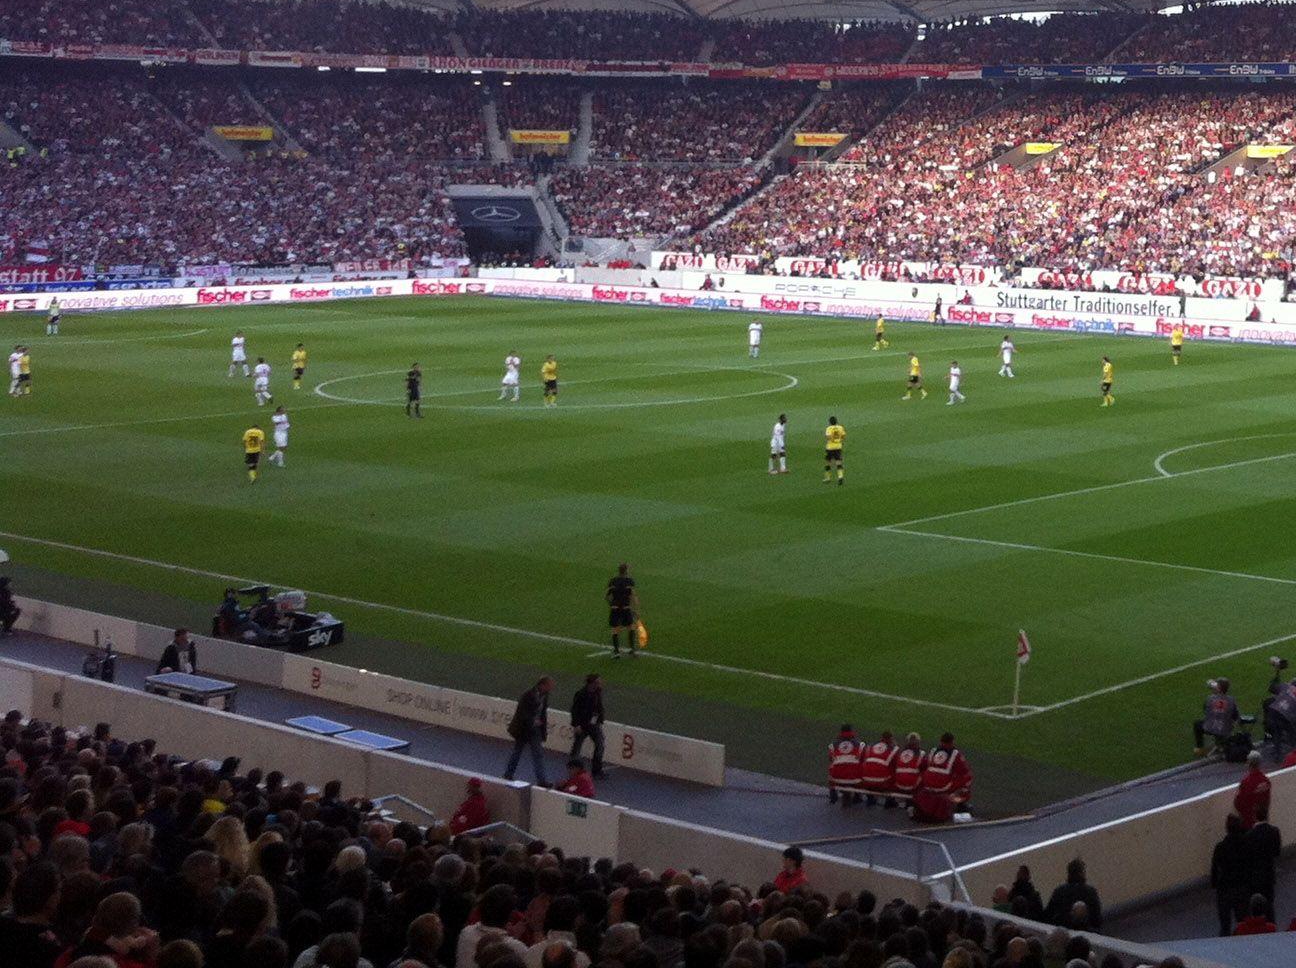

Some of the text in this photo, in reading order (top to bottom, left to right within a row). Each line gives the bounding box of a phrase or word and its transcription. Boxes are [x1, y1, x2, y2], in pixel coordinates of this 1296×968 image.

[1229, 65, 1258, 74] EnBW
[290, 286, 374, 299] fischertechnik
[412, 280, 462, 295] fischer
[592, 285, 629, 301] fischer
[1206, 279, 1260, 298] GAZI
[120, 293, 184, 307] solutions
[197, 289, 248, 303] fischer
[761, 295, 801, 312] fischer
[997, 291, 1174, 317] Stuttgarter Traditionselfer.
[948, 306, 992, 323] fischer
[1032, 311, 1115, 331] fischertechnik
[307, 629, 334, 648] sky
